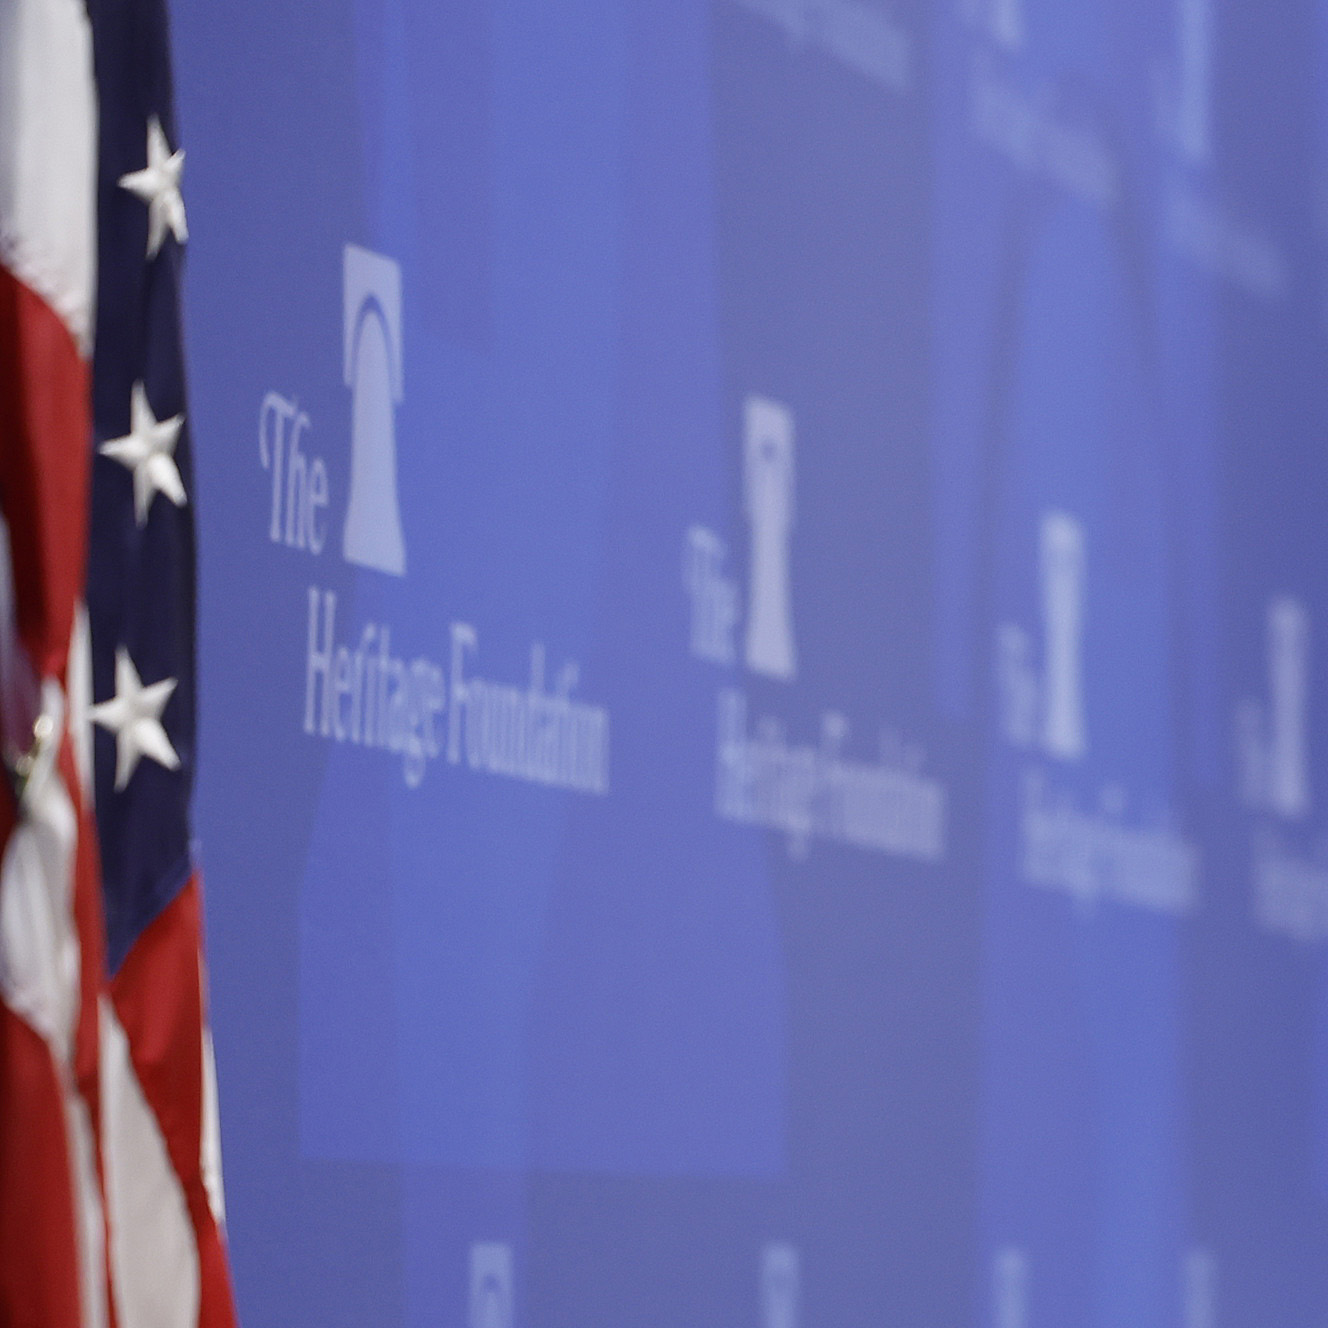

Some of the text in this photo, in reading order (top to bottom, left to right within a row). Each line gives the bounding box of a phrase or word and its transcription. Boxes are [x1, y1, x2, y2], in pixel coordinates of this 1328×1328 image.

[259, 391, 328, 555] The
[304, 586, 609, 794] Heritage Foundation
